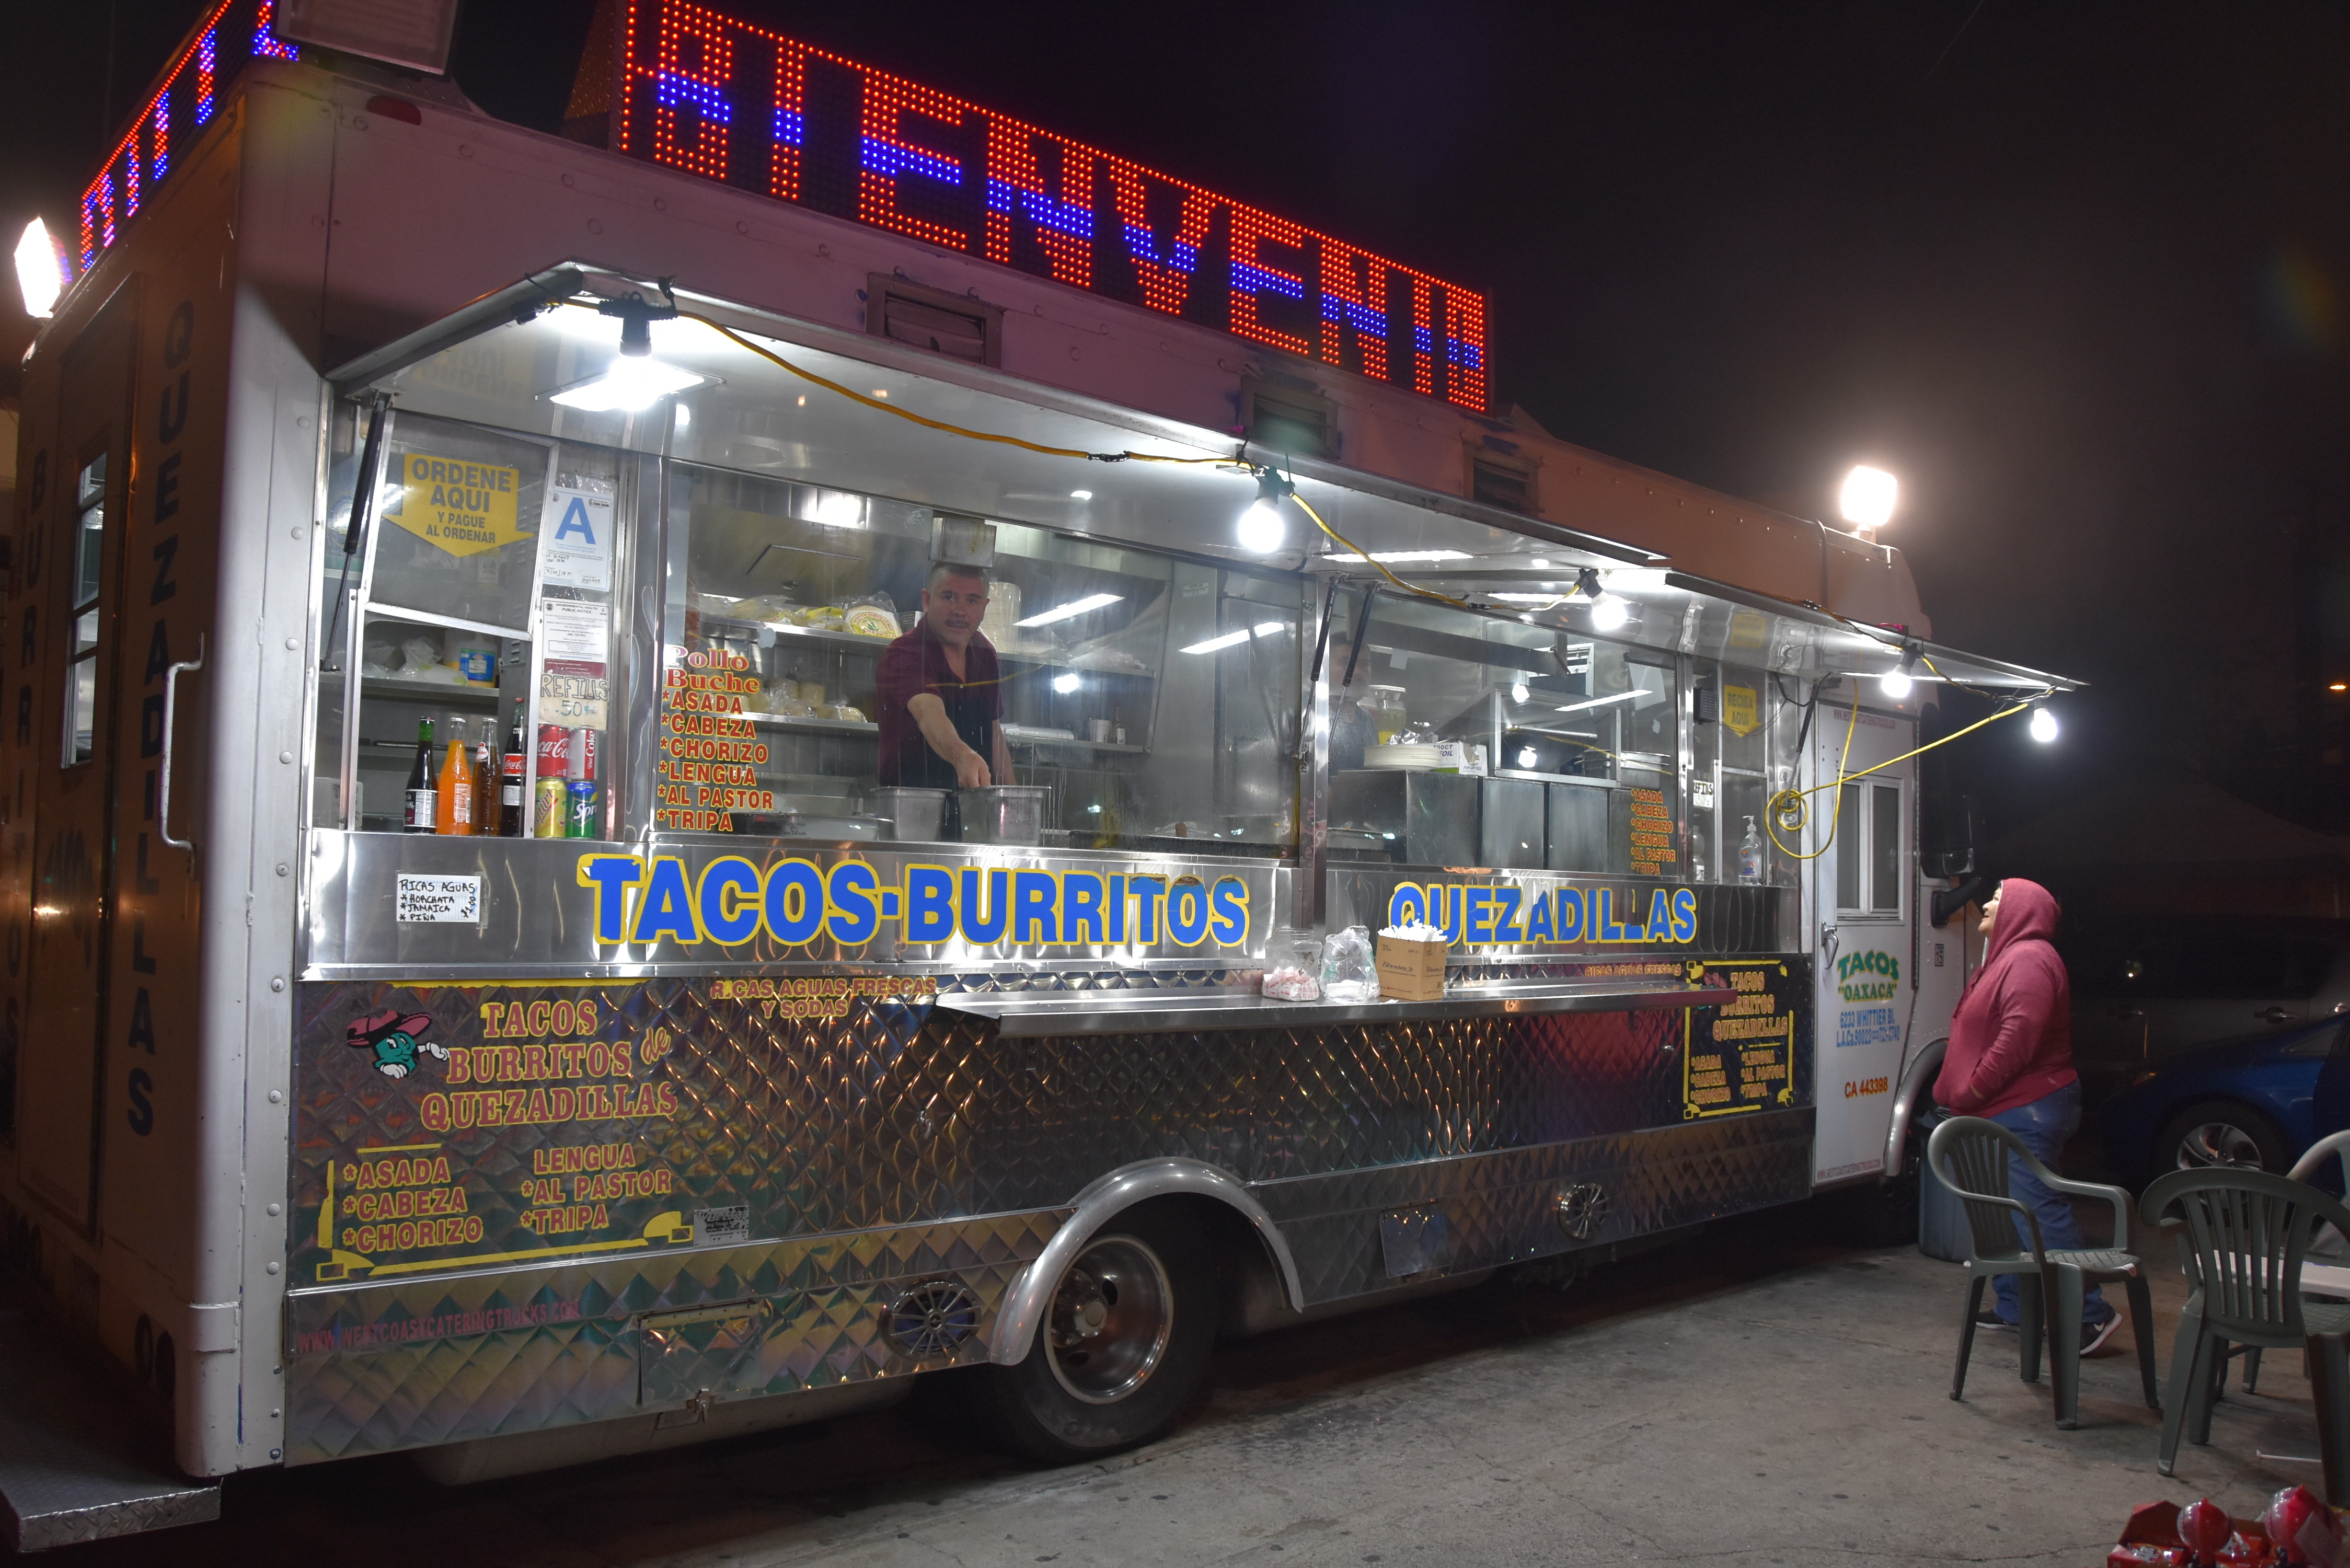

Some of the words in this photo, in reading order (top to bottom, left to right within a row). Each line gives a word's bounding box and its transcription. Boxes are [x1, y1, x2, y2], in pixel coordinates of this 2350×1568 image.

[411, 458, 512, 492] ORDENE
[430, 486, 490, 513] AQUI
[437, 511, 445, 523] Y
[448, 513, 485, 528] PAGUE
[555, 497, 596, 545] A
[425, 524, 440, 537] AL
[443, 527, 496, 544] ORDENAR
[664, 644, 749, 671] Pollo
[540, 674, 608, 701] REFILLS
[664, 668, 759, 693] Buche
[670, 690, 743, 714] ASADA
[1727, 693, 1753, 709] RECIBA
[670, 713, 756, 740] CABEZA
[1732, 711, 1749, 727] AQUI
[585, 730, 596, 756] Coke
[670, 737, 768, 764] CHORIZO
[669, 761, 756, 786] LENGUA
[666, 785, 690, 805] AL
[698, 788, 773, 810] PASTOR
[1635, 789, 1663, 804] ASADA
[667, 809, 733, 832] TRIPA
[1635, 803, 1668, 818] CABEZA
[1635, 818, 1673, 834] CHORIZO
[1635, 832, 1669, 848] LENGUA
[1634, 847, 1644, 860] AL
[1647, 848, 1676, 862] PASTOR
[1635, 862, 1661, 875] TRIPA
[399, 879, 435, 892] RICAS
[442, 881, 476, 894] AGUAS
[407, 904, 451, 913] JAMAICA
[409, 894, 455, 904] HORCHATA
[1585, 966, 1612, 977] RICAS
[1614, 965, 1643, 976] AGUAS
[1645, 964, 1681, 976] FRESCAS
[1837, 949, 1899, 984] TACOS
[779, 978, 847, 998] AGUAS
[852, 977, 937, 996] FRESCAS
[1730, 971, 1765, 991] TACOS
[1838, 982, 1897, 1002] "OAXACA"
[480, 999, 598, 1038] TACOS
[761, 1000, 776, 1019] Y
[780, 999, 848, 1019] SODAS
[1857, 1009, 1886, 1027] WHITTIER
[1713, 1016, 1788, 1042] QUEZADILLAS
[446, 1041, 631, 1084] BURRITOS
[641, 1027, 671, 1065] de
[1695, 1054, 1722, 1071] ASADA
[1745, 1050, 1775, 1066] LENGUA
[1695, 1070, 1726, 1088] CABEZA
[1756, 1064, 1785, 1081] PASTOR
[1694, 1086, 1731, 1105] CHORIZO
[1745, 1082, 1768, 1098] TRIPA
[1845, 1081, 1858, 1099] CA
[421, 1081, 678, 1132] QUEZADILLAS
[534, 1143, 636, 1175] LENGUA
[356, 1157, 450, 1190] ASADA
[533, 1179, 566, 1206] AL
[574, 1169, 672, 1201] PASTOR
[357, 1187, 468, 1221] CABEZA
[534, 1204, 609, 1234] TRIPA
[357, 1216, 483, 1253] CHORIZO
